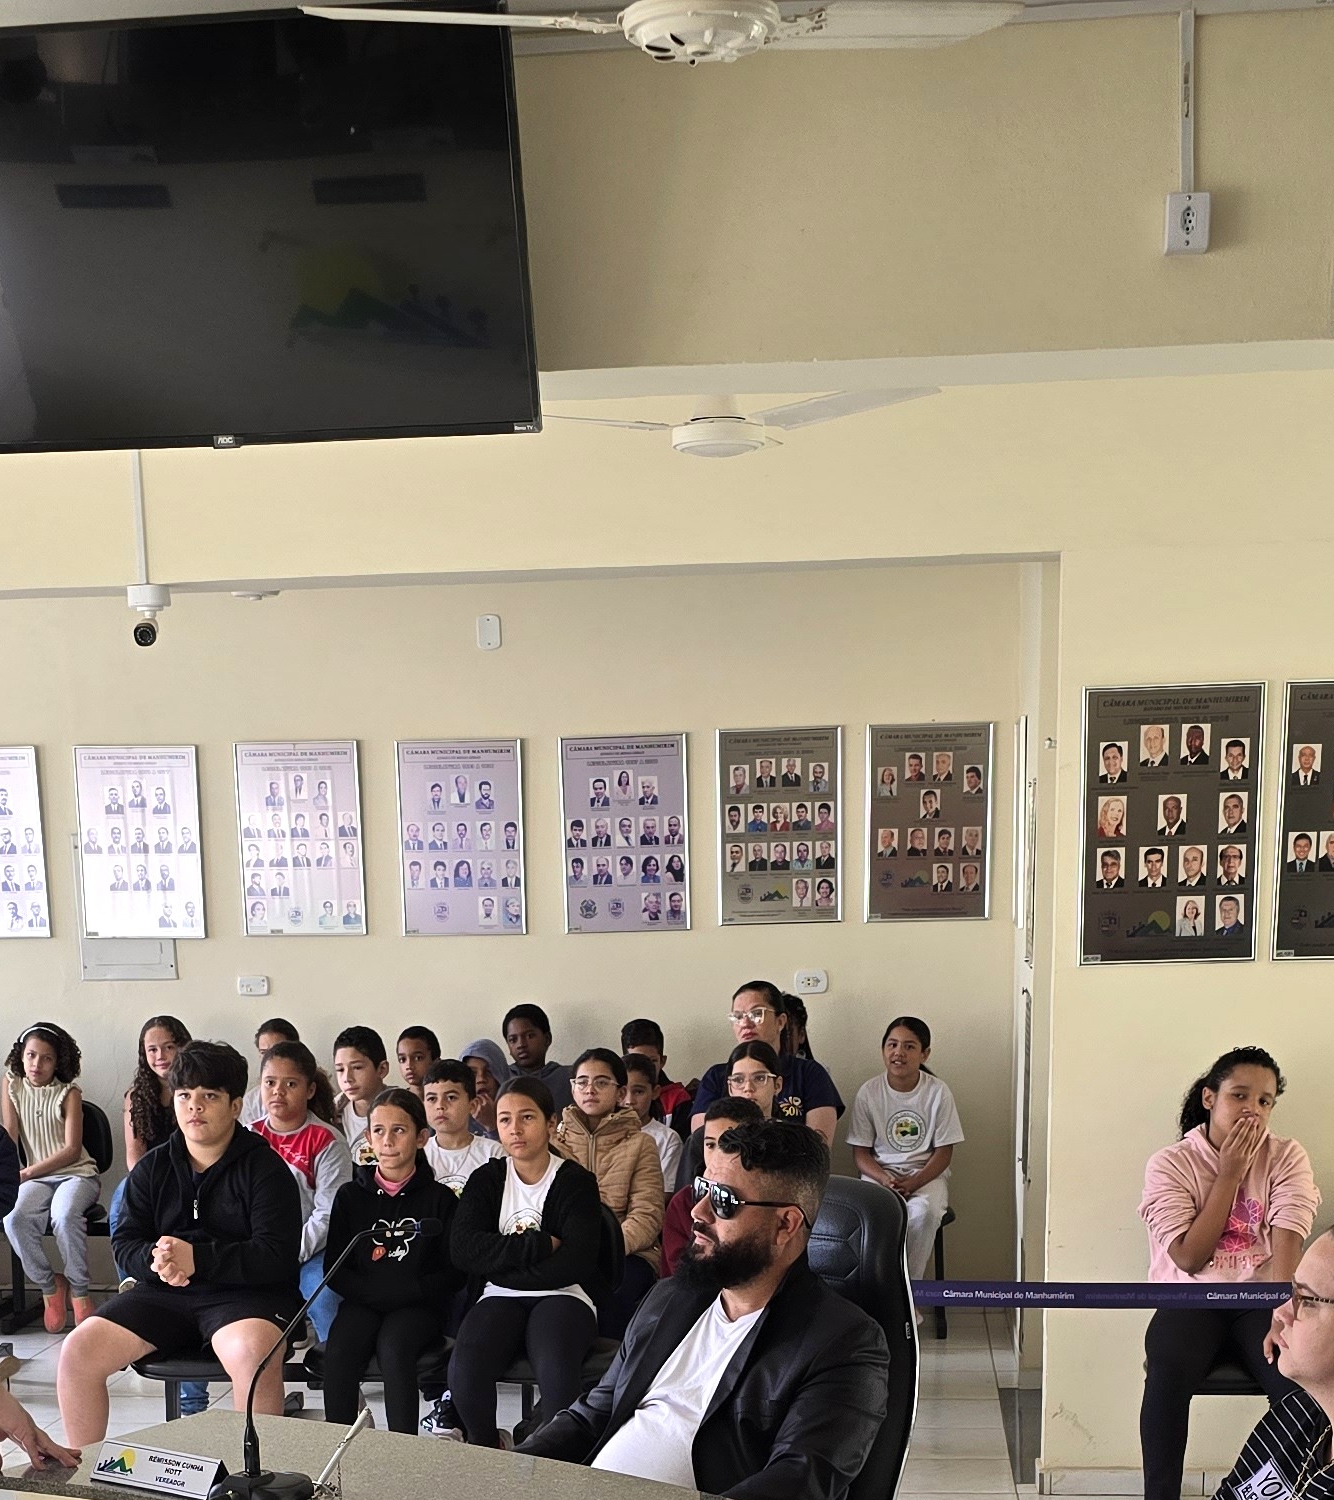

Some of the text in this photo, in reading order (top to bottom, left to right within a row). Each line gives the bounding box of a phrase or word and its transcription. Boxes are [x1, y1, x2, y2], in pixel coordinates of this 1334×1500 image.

[218, 436, 234, 445] AOC
[1300, 690, 1334, 701] CÂMARA
[1103, 695, 1250, 708] CÂMARA MUNICIPAL DE MANHUMIRIM
[942, 1289, 974, 1298] Câmara
[975, 1290, 1012, 1300] Municipal
[1014, 1291, 1024, 1299] de
[1025, 1291, 1075, 1300] Manhumirim
[1206, 1292, 1238, 1300] Câmara
[1239, 1292, 1278, 1301] Municipal
[1280, 1292, 1290, 1300] de
